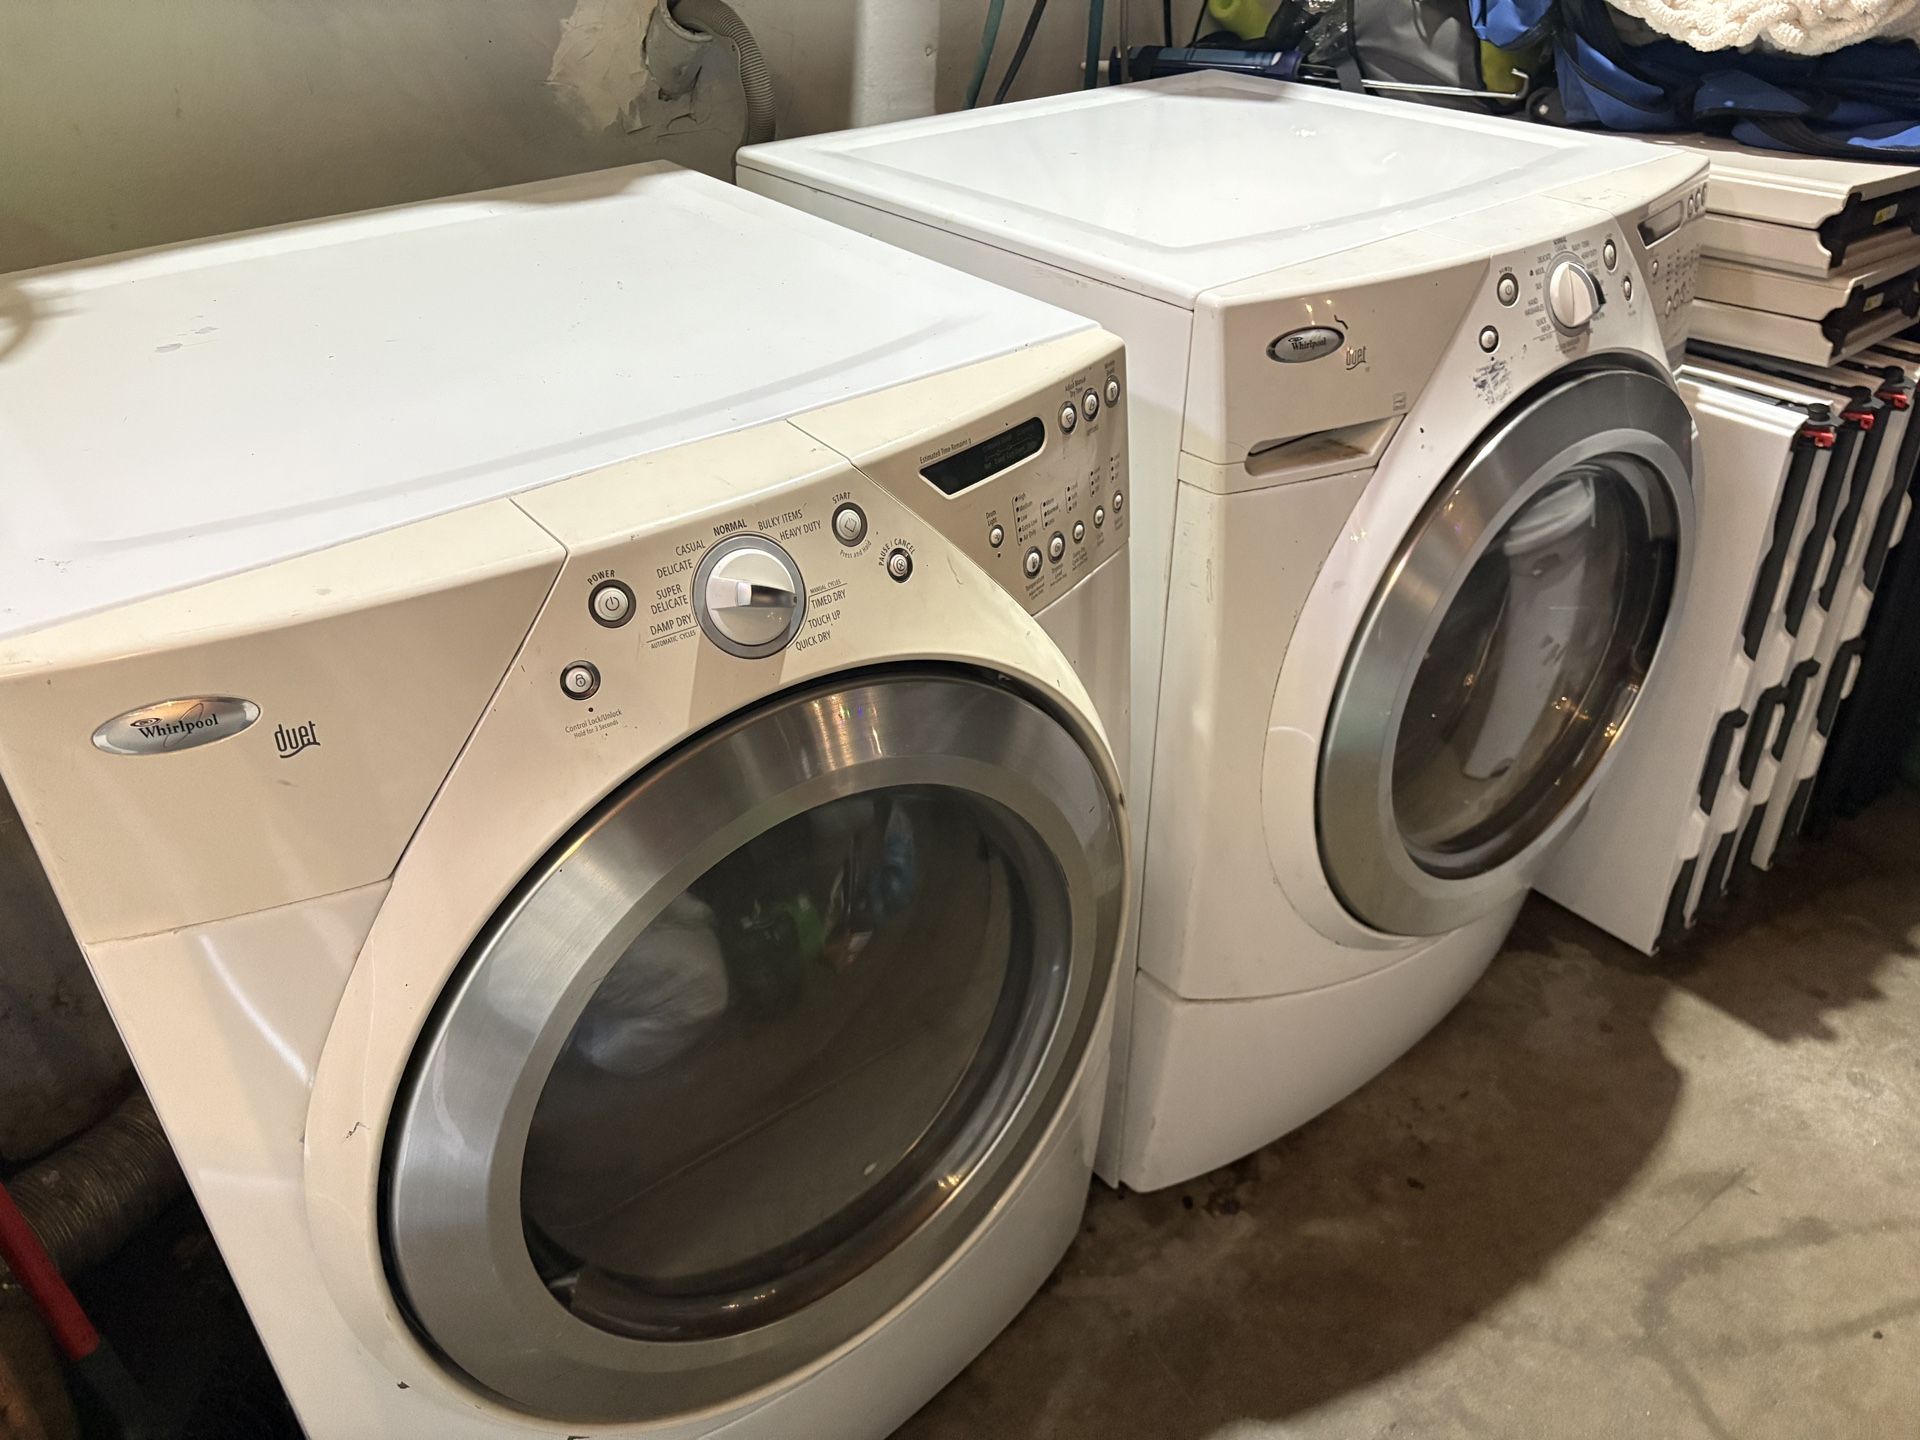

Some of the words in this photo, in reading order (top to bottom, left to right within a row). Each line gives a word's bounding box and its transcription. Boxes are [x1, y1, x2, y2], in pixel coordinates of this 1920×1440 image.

[1291, 337, 1327, 351] Whirlpool
[832, 492, 851, 504] START
[758, 516, 780, 531] BULKY
[781, 509, 803, 524] ITEMS
[985, 510, 997, 519] Drum
[713, 519, 747, 536] NORMAL
[780, 525, 802, 541] HEAVY
[803, 520, 821, 534] DUTY
[675, 540, 706, 557] CASUAL
[839, 549, 853, 559] Press
[853, 549, 863, 559] and
[862, 540, 872, 555] Hold
[879, 543, 891, 566] PAUSE
[894, 538, 916, 555] CANCEL
[587, 569, 615, 586] POWER
[656, 559, 694, 579] DELICATE
[656, 584, 683, 600] SUPER
[811, 597, 832, 609] TIMED
[833, 589, 847, 602] DRY
[650, 594, 688, 615] DELICATE
[650, 619, 674, 636] DAMP
[676, 614, 692, 628] DRY
[808, 613, 831, 629] TOUCH
[831, 609, 841, 620] UP
[650, 636, 678, 649] AUTOMATIC
[680, 630, 696, 641] CYCLES
[795, 635, 817, 651] QUICK
[818, 630, 831, 643] DRY
[138, 714, 219, 739] Whirlpool
[565, 719, 588, 733] Control
[588, 709, 622, 726] Lock/Unlock
[274, 720, 320, 755] duet
